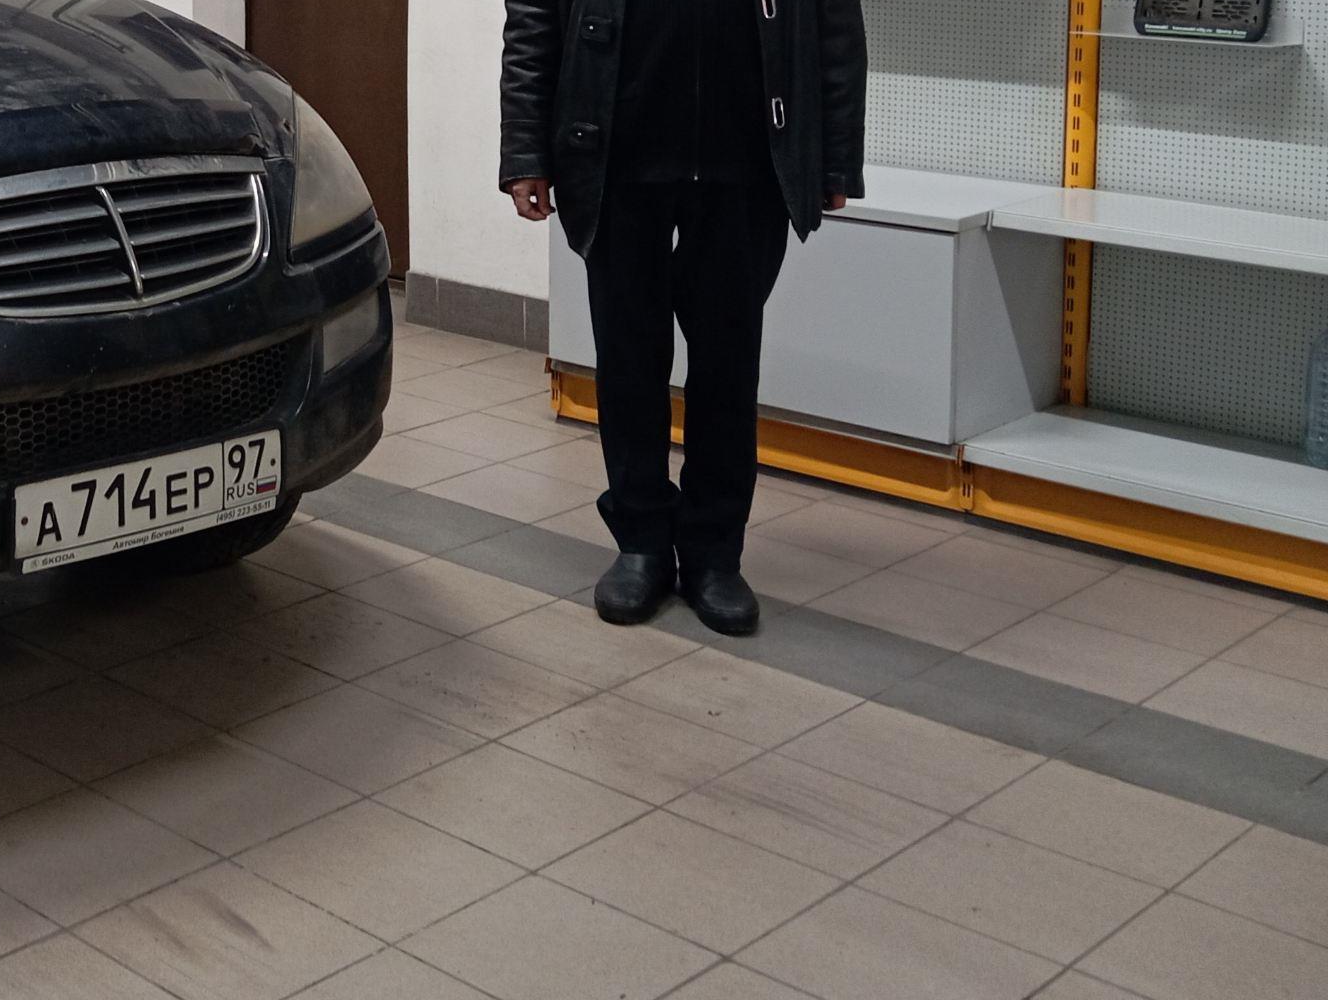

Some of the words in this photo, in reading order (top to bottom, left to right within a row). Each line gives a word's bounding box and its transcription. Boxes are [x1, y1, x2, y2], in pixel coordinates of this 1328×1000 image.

[227, 438, 265, 483] 97
[226, 480, 255, 502] RUS
[112, 534, 150, 551] Автомир
[150, 525, 185, 542] Богемия
